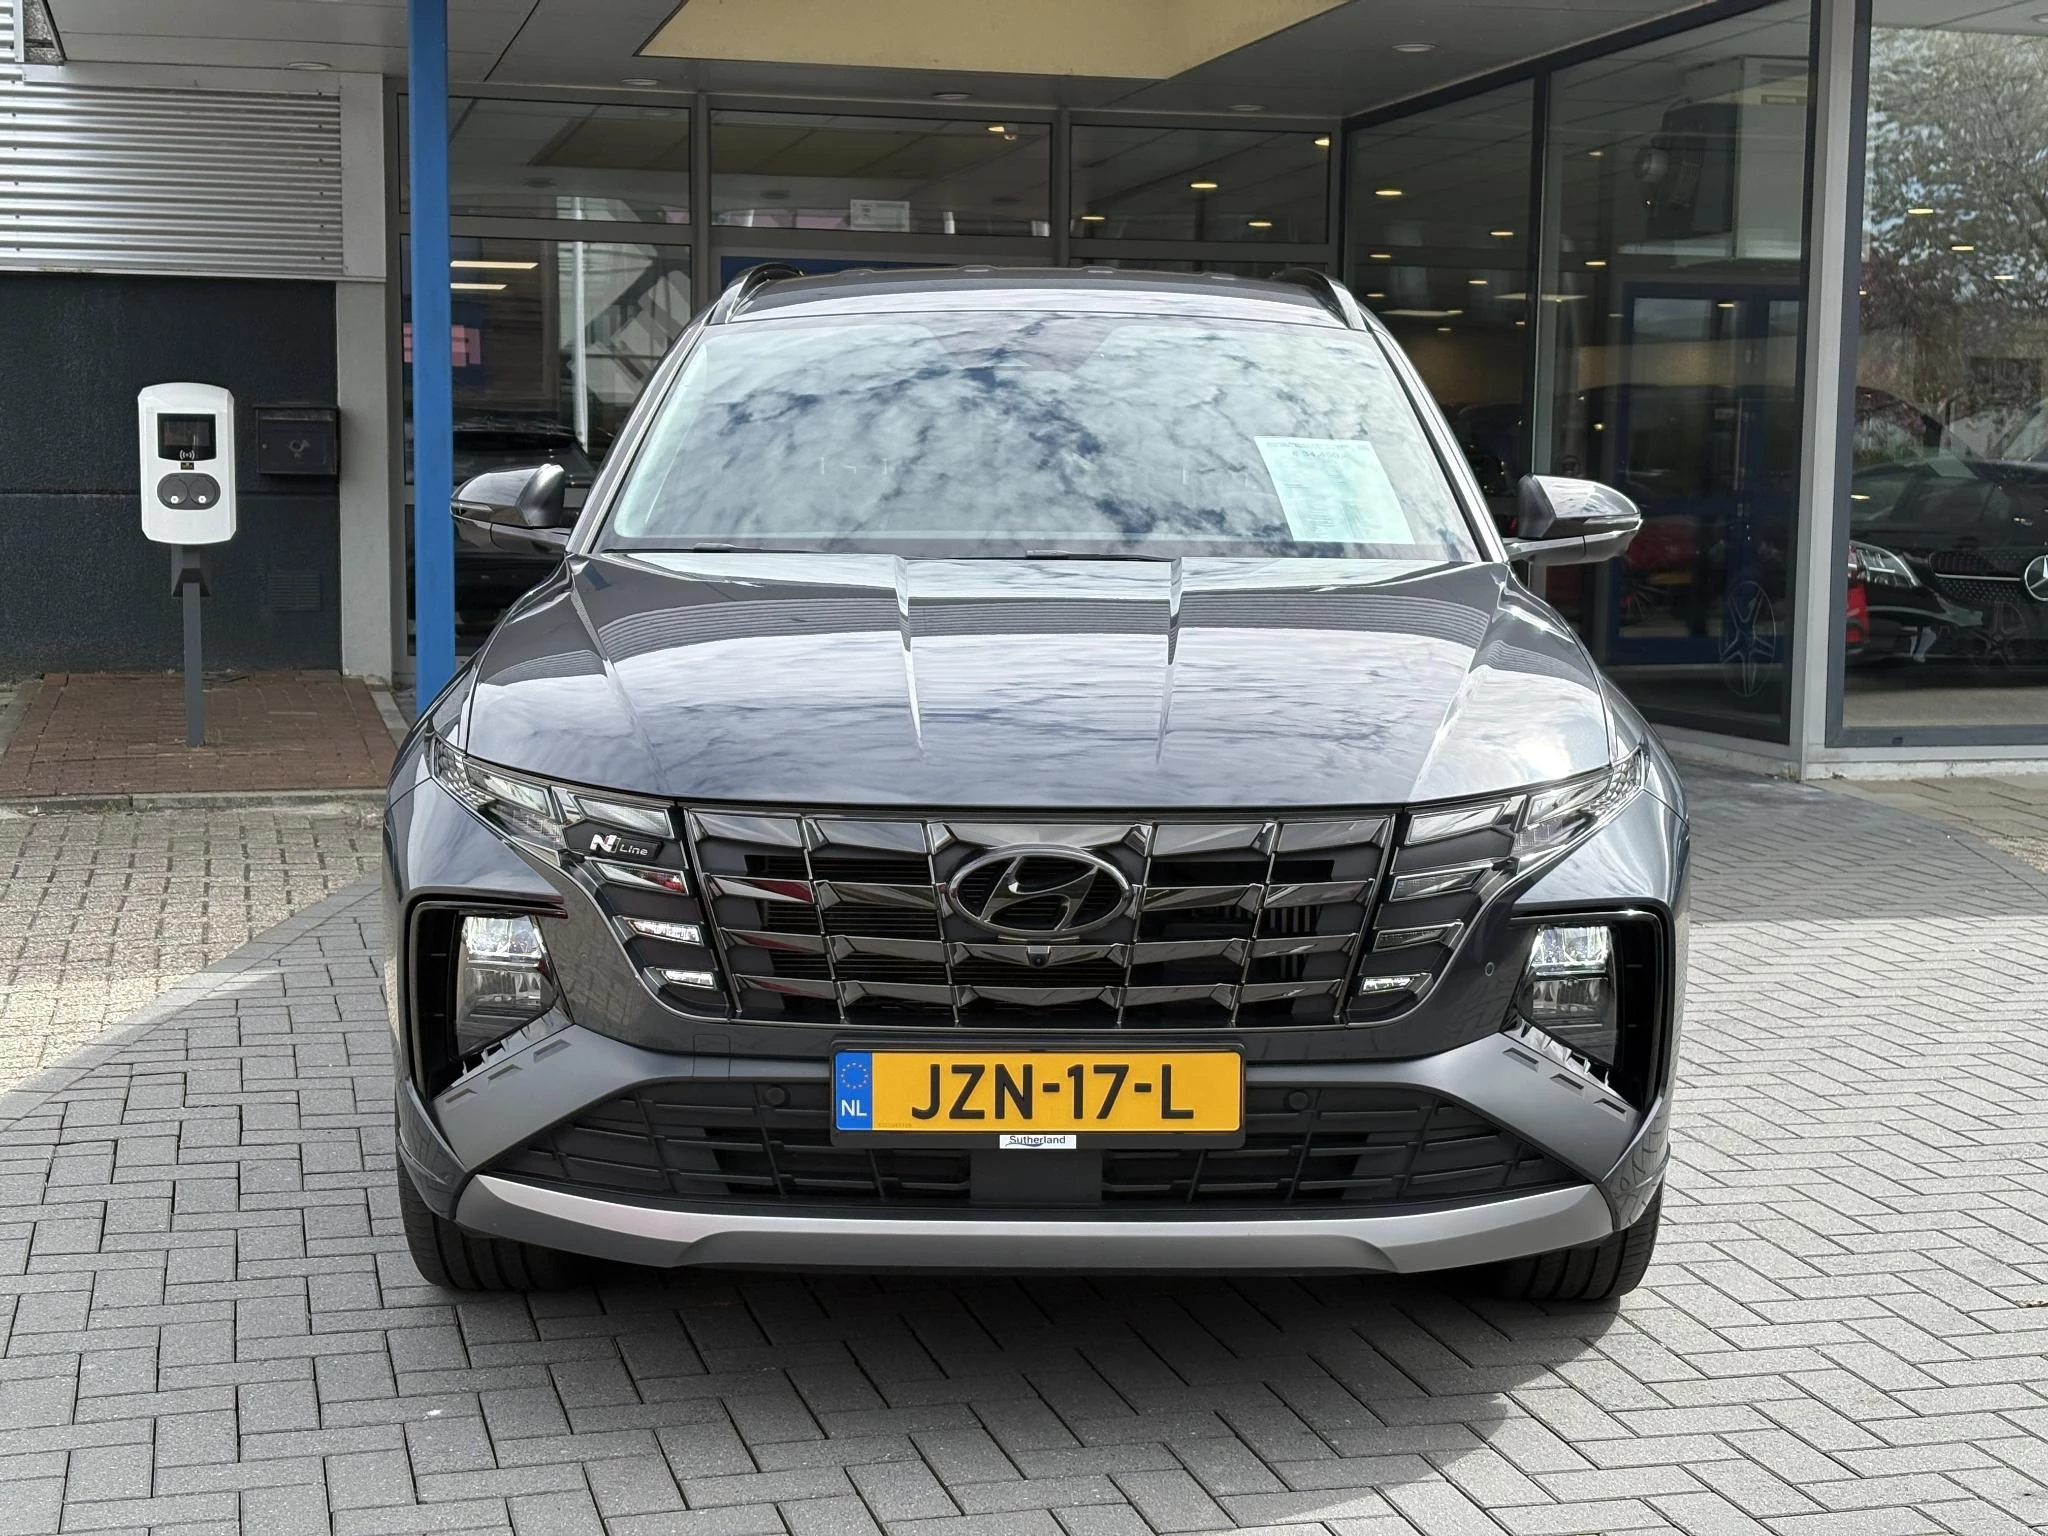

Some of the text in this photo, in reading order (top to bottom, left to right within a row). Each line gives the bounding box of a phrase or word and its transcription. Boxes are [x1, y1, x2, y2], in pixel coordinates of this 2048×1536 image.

[620, 843, 648, 856] Line
[911, 1063, 1194, 1120] JZN-17-L
[841, 1099, 867, 1117] NL
[1009, 1135, 1066, 1145] Sutherland
